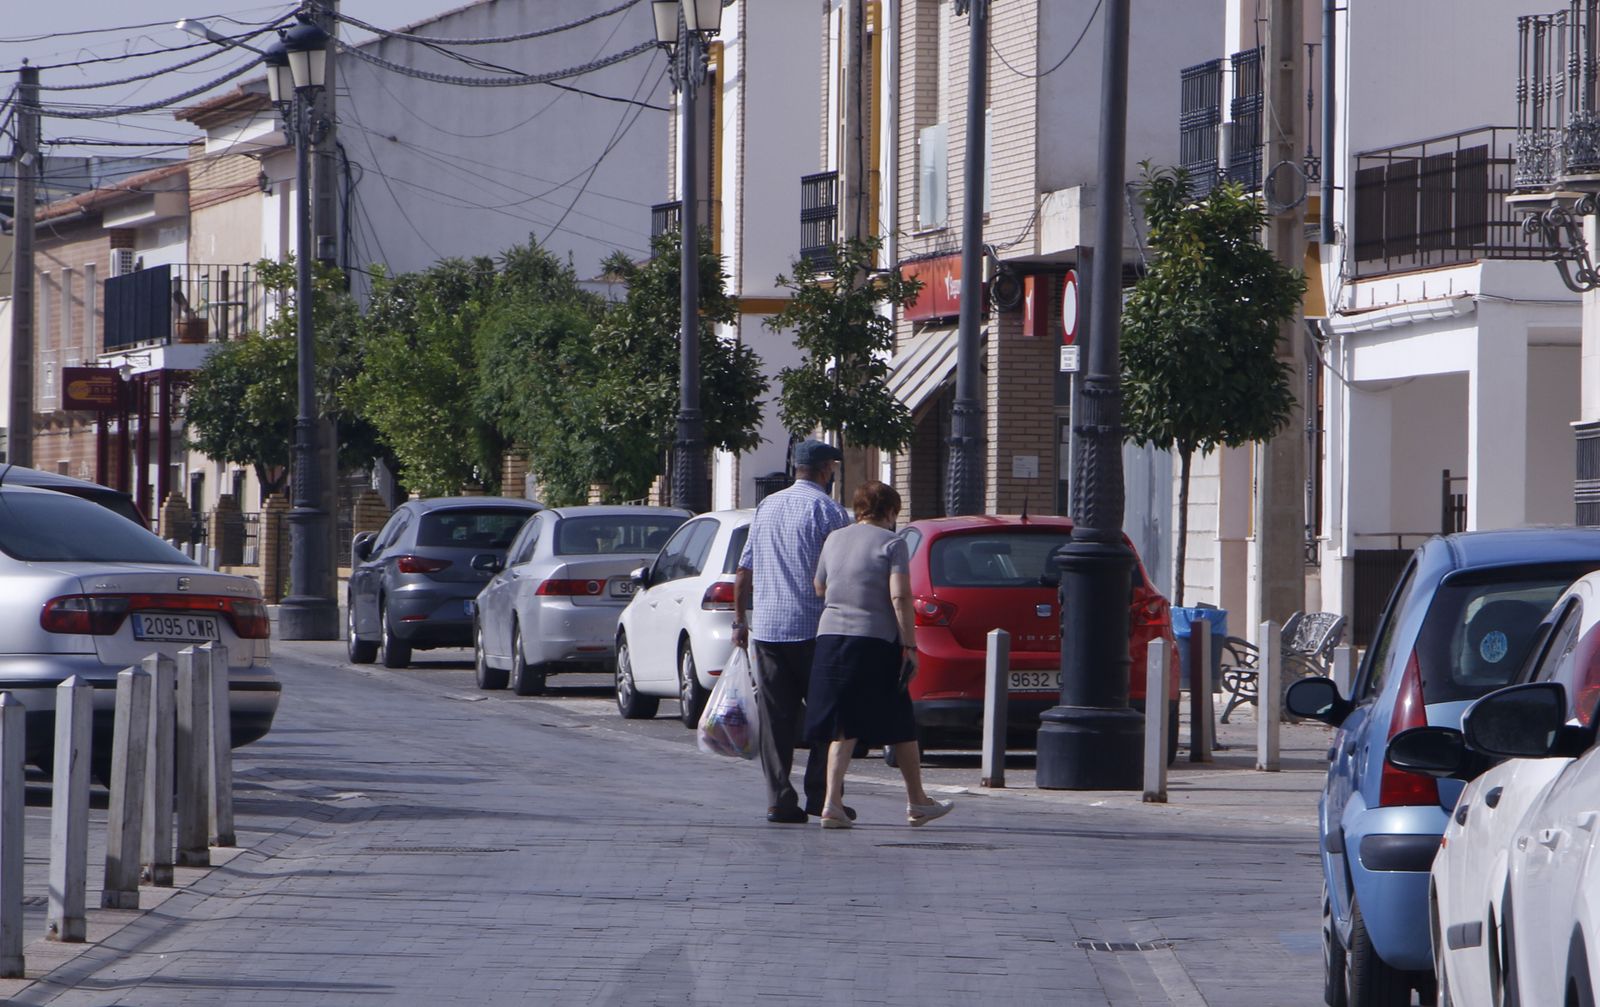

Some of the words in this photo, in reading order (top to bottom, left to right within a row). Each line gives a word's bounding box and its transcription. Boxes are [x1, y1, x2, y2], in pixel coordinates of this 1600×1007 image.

[144, 617, 183, 635] 2095
[187, 619, 215, 637] CWR
[1011, 672, 1050, 687] 9632
